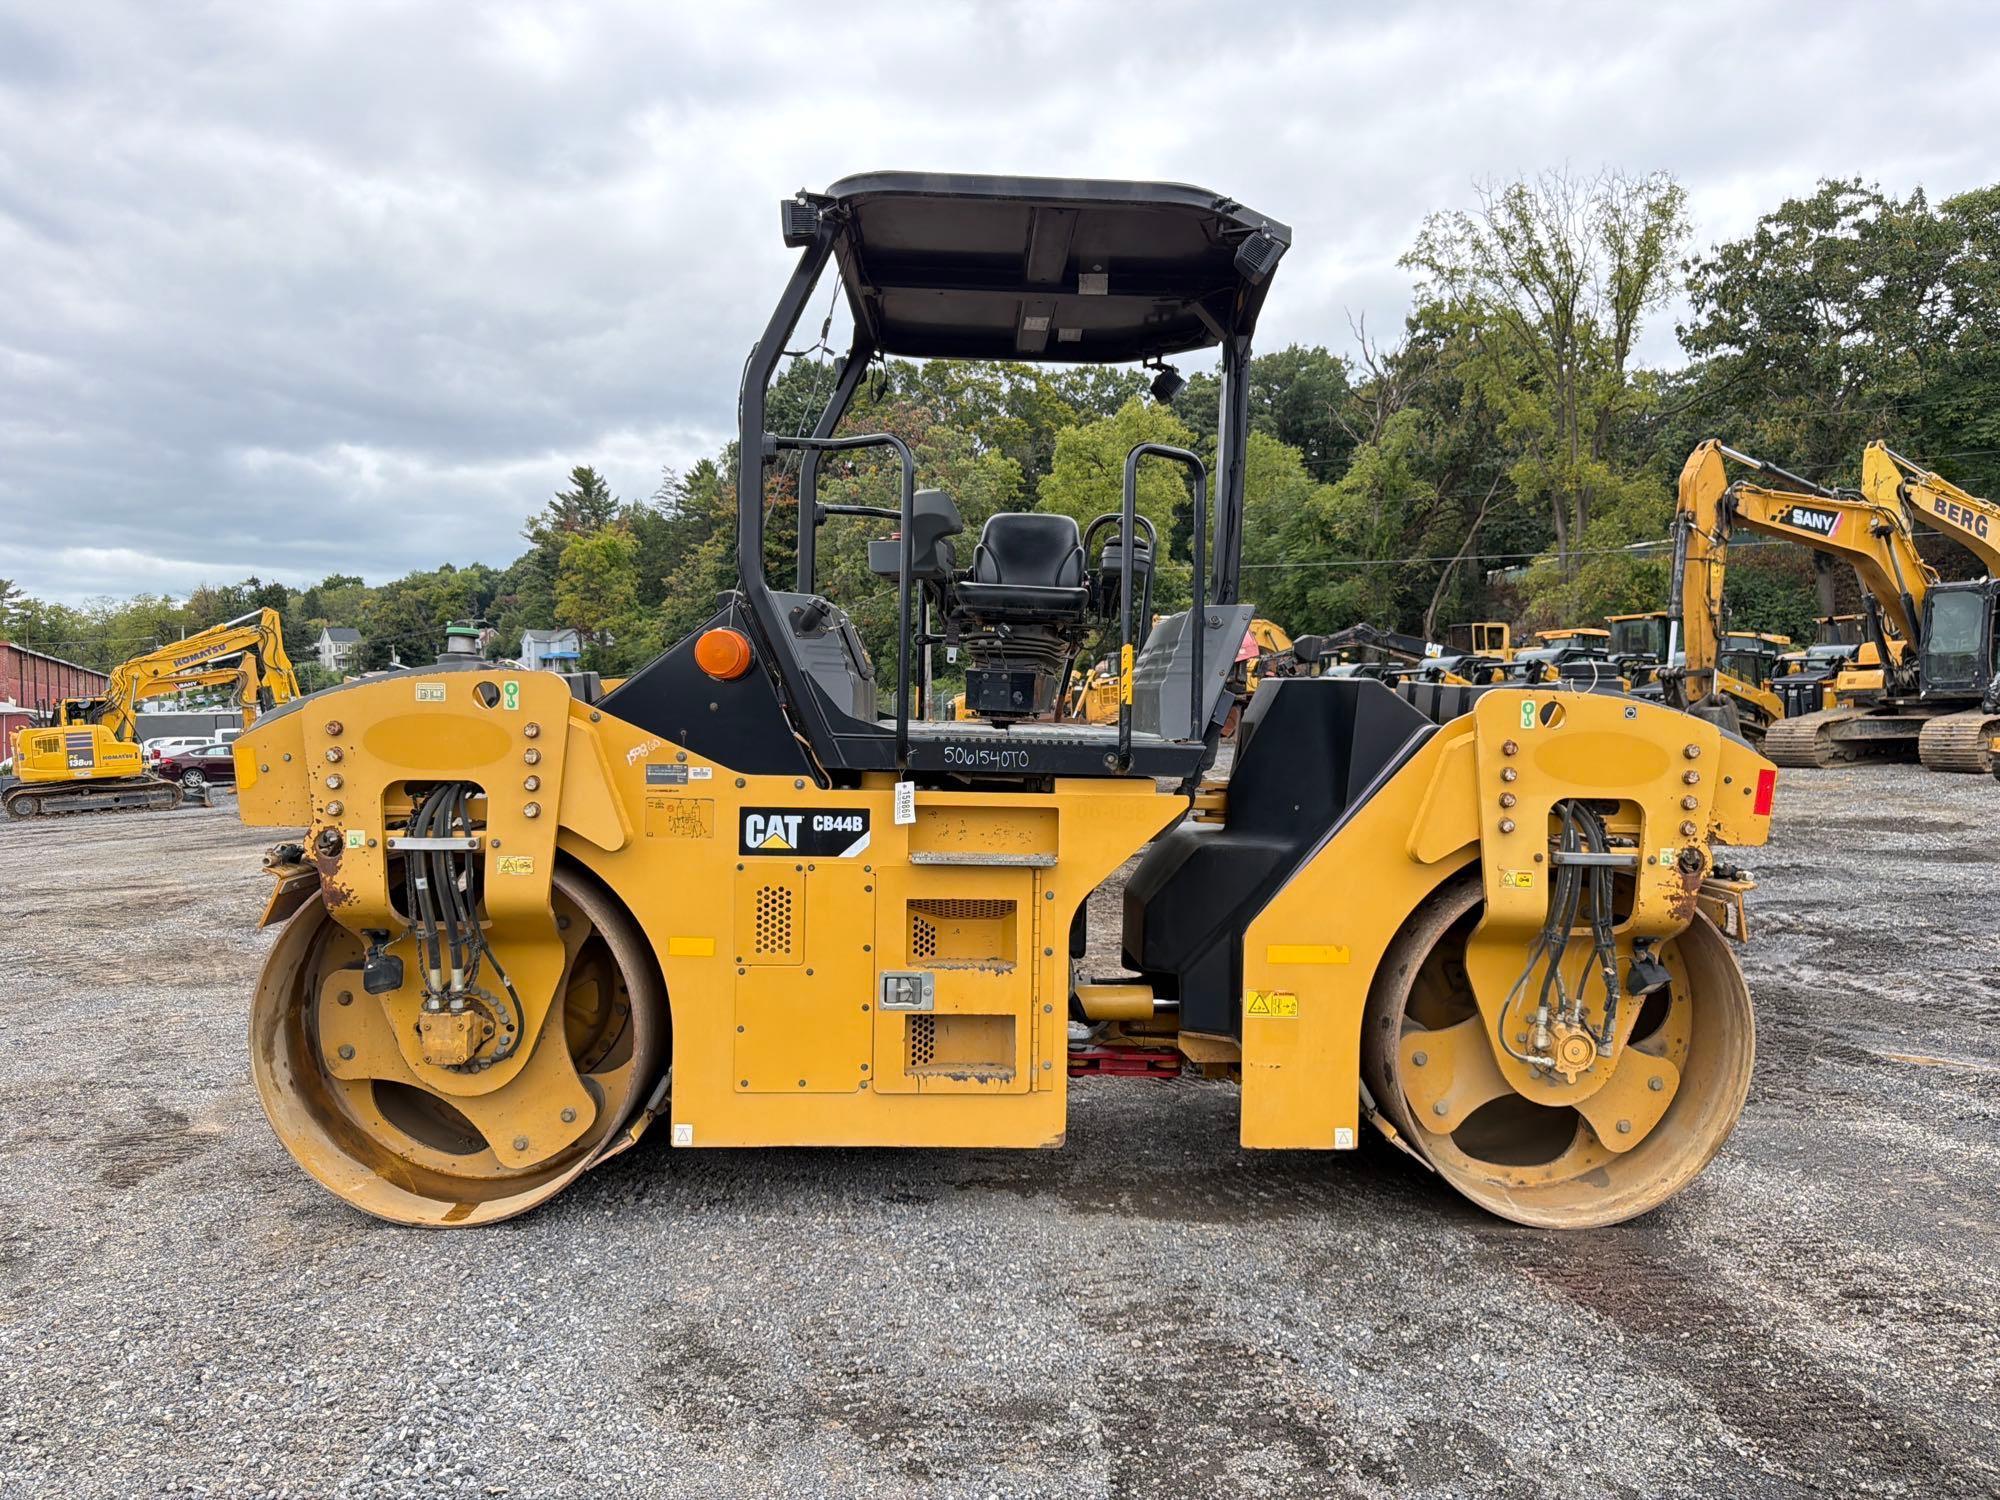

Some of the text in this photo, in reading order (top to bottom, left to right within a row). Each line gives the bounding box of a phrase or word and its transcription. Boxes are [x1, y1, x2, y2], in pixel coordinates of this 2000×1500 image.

[1793, 509, 1832, 530] SANY
[1934, 497, 1988, 539] BERG
[173, 643, 227, 667] KOMATSU
[1425, 642, 1443, 658] CAT
[745, 814, 863, 849] CAT CB44B
